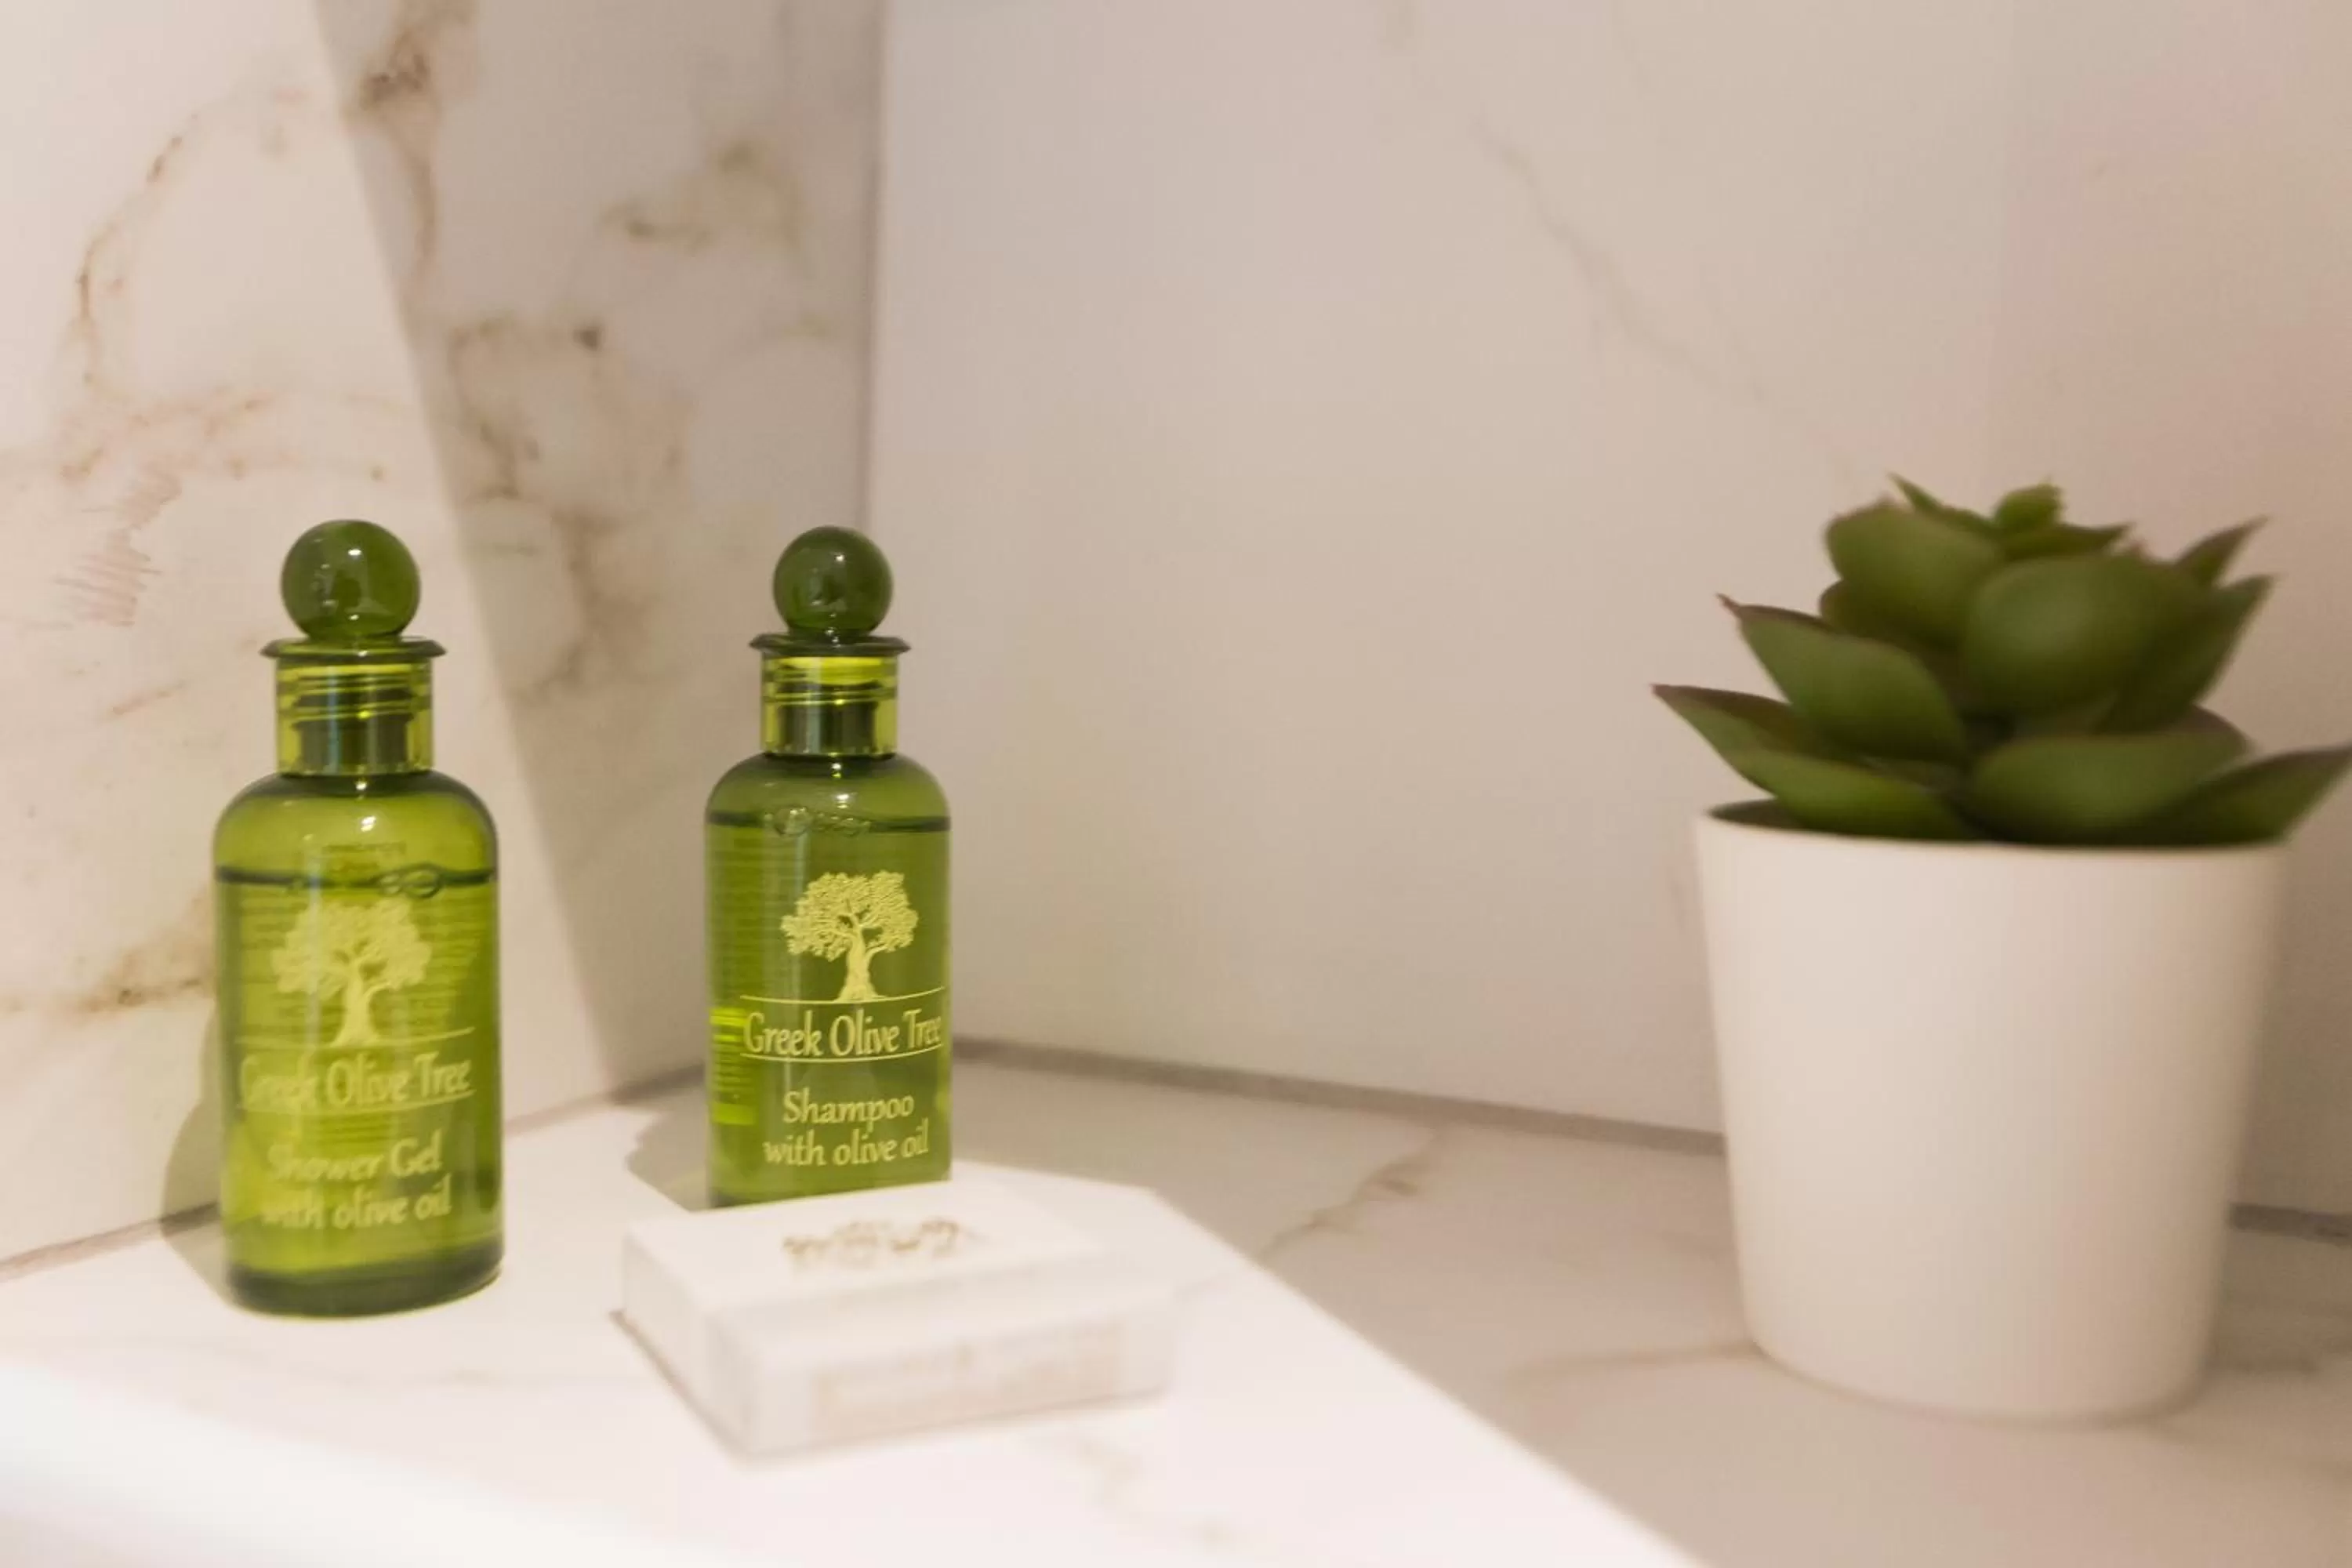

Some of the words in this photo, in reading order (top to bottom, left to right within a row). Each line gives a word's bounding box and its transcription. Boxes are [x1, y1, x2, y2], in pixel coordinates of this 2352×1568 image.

[743, 1010, 823, 1056] Greek
[830, 1008, 900, 1056] Olive
[903, 1008, 942, 1051] Tree
[326, 1053, 409, 1106] Olive
[414, 1051, 470, 1097] Tree
[784, 1087, 915, 1131] Shampoo
[268, 1142, 384, 1181] Shower
[390, 1128, 442, 1177] Gel
[762, 1130, 826, 1167] with
[832, 1129, 897, 1166] olive
[902, 1118, 929, 1159] oil
[263, 1189, 325, 1230] with
[333, 1184, 408, 1229] olive
[414, 1173, 452, 1220] oil
